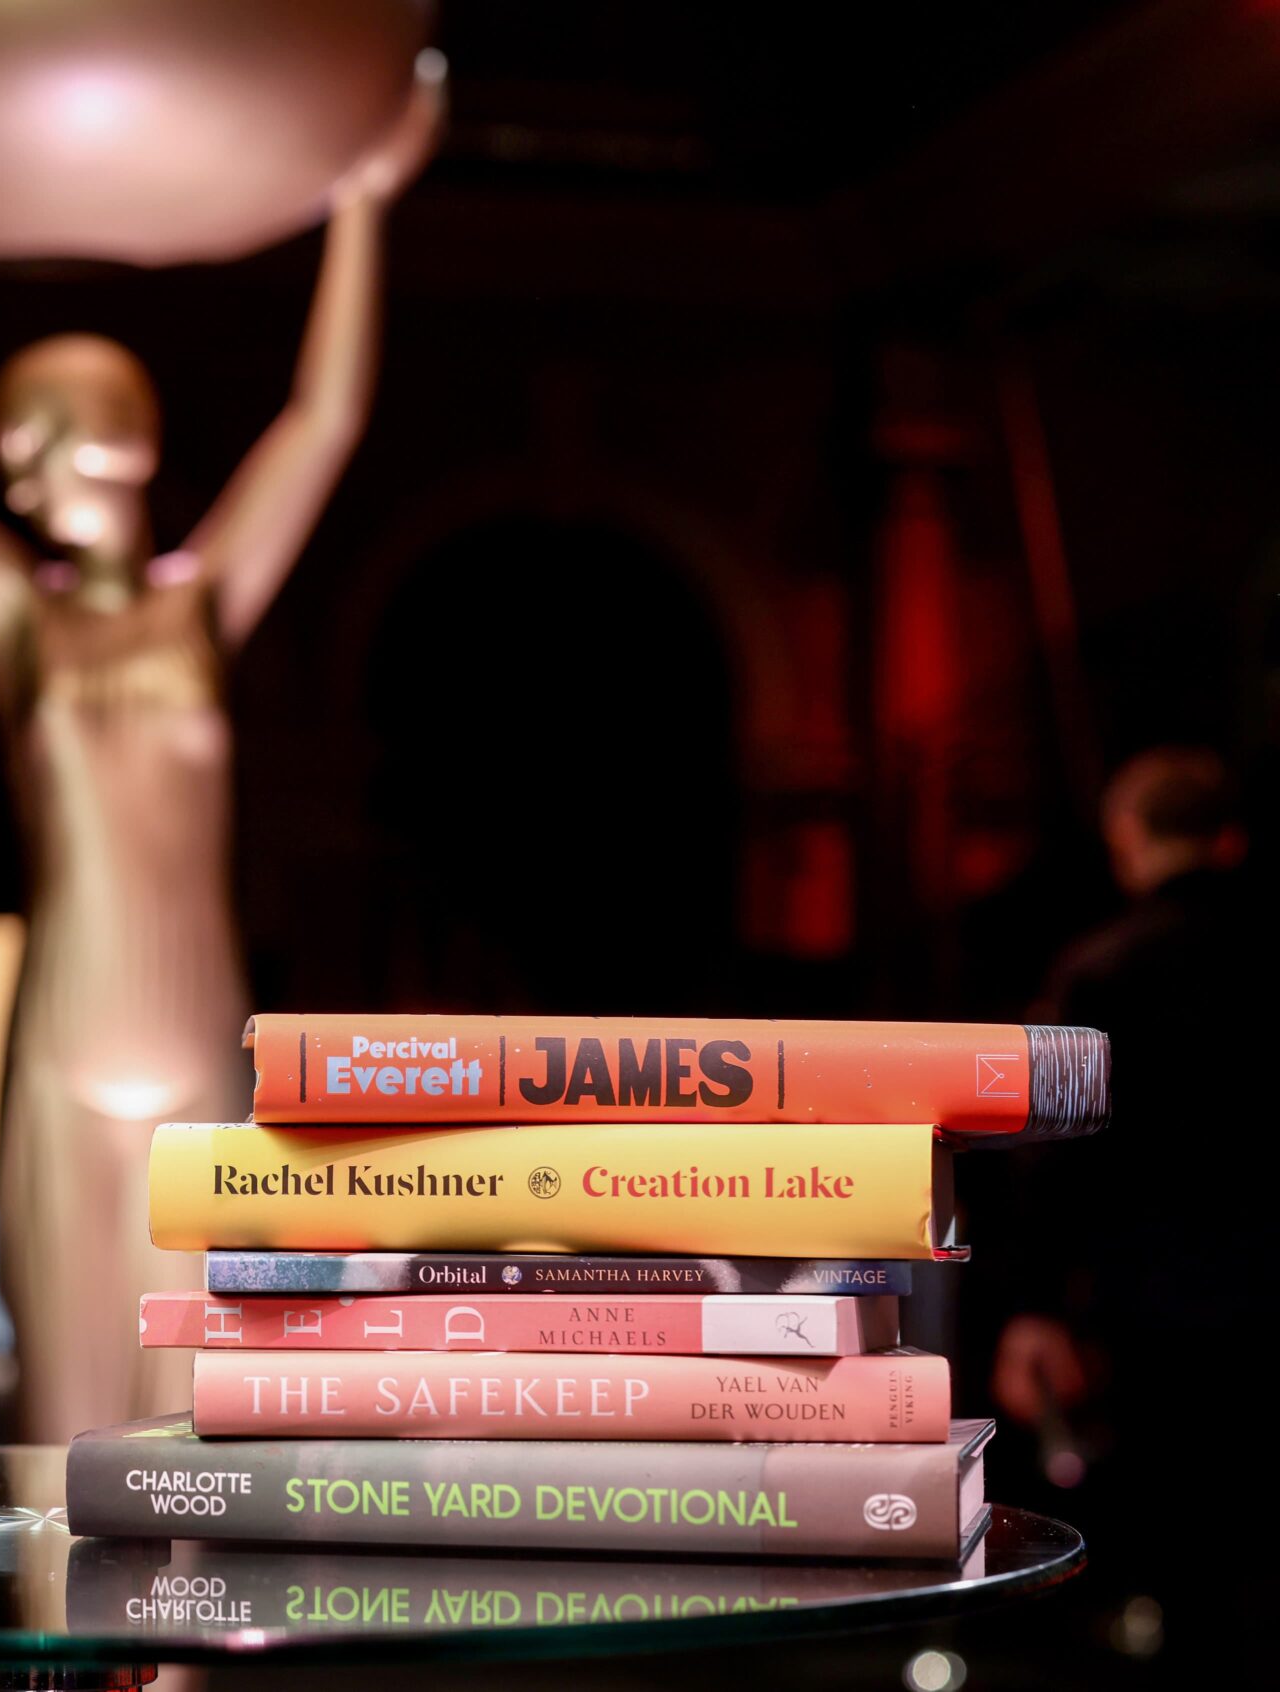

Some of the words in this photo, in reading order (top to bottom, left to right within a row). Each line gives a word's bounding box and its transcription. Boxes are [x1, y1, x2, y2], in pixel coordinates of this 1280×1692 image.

[352, 1036, 457, 1060] Percival
[326, 1056, 483, 1096] Everett
[519, 1036, 754, 1108] JAMES
[213, 1164, 334, 1196] Rachel
[347, 1165, 504, 1197] Kushner
[582, 1165, 750, 1198] Creation
[763, 1166, 855, 1199] Lake
[419, 1265, 487, 1285] Orbital
[535, 1268, 632, 1283] SAMANTHA
[637, 1269, 705, 1283] HARVEY
[813, 1269, 887, 1285] VINTAGE
[568, 1307, 635, 1323] ANNE
[539, 1330, 667, 1347] MICHAELS
[716, 1375, 767, 1393] YAEL
[776, 1375, 819, 1393] VAN
[243, 1376, 345, 1415] THE
[375, 1376, 650, 1417] SAFEKEEP
[889, 1370, 898, 1429] PENGUIN
[905, 1375, 914, 1424] VIKING
[691, 1403, 736, 1420] DER
[746, 1403, 846, 1421] WOUDEN
[125, 1469, 252, 1494] CHARLOTTE
[150, 1494, 227, 1516] WOOD
[285, 1477, 410, 1517] STONE
[423, 1481, 521, 1520] YARD
[535, 1485, 798, 1528] DEVOTIONAL
